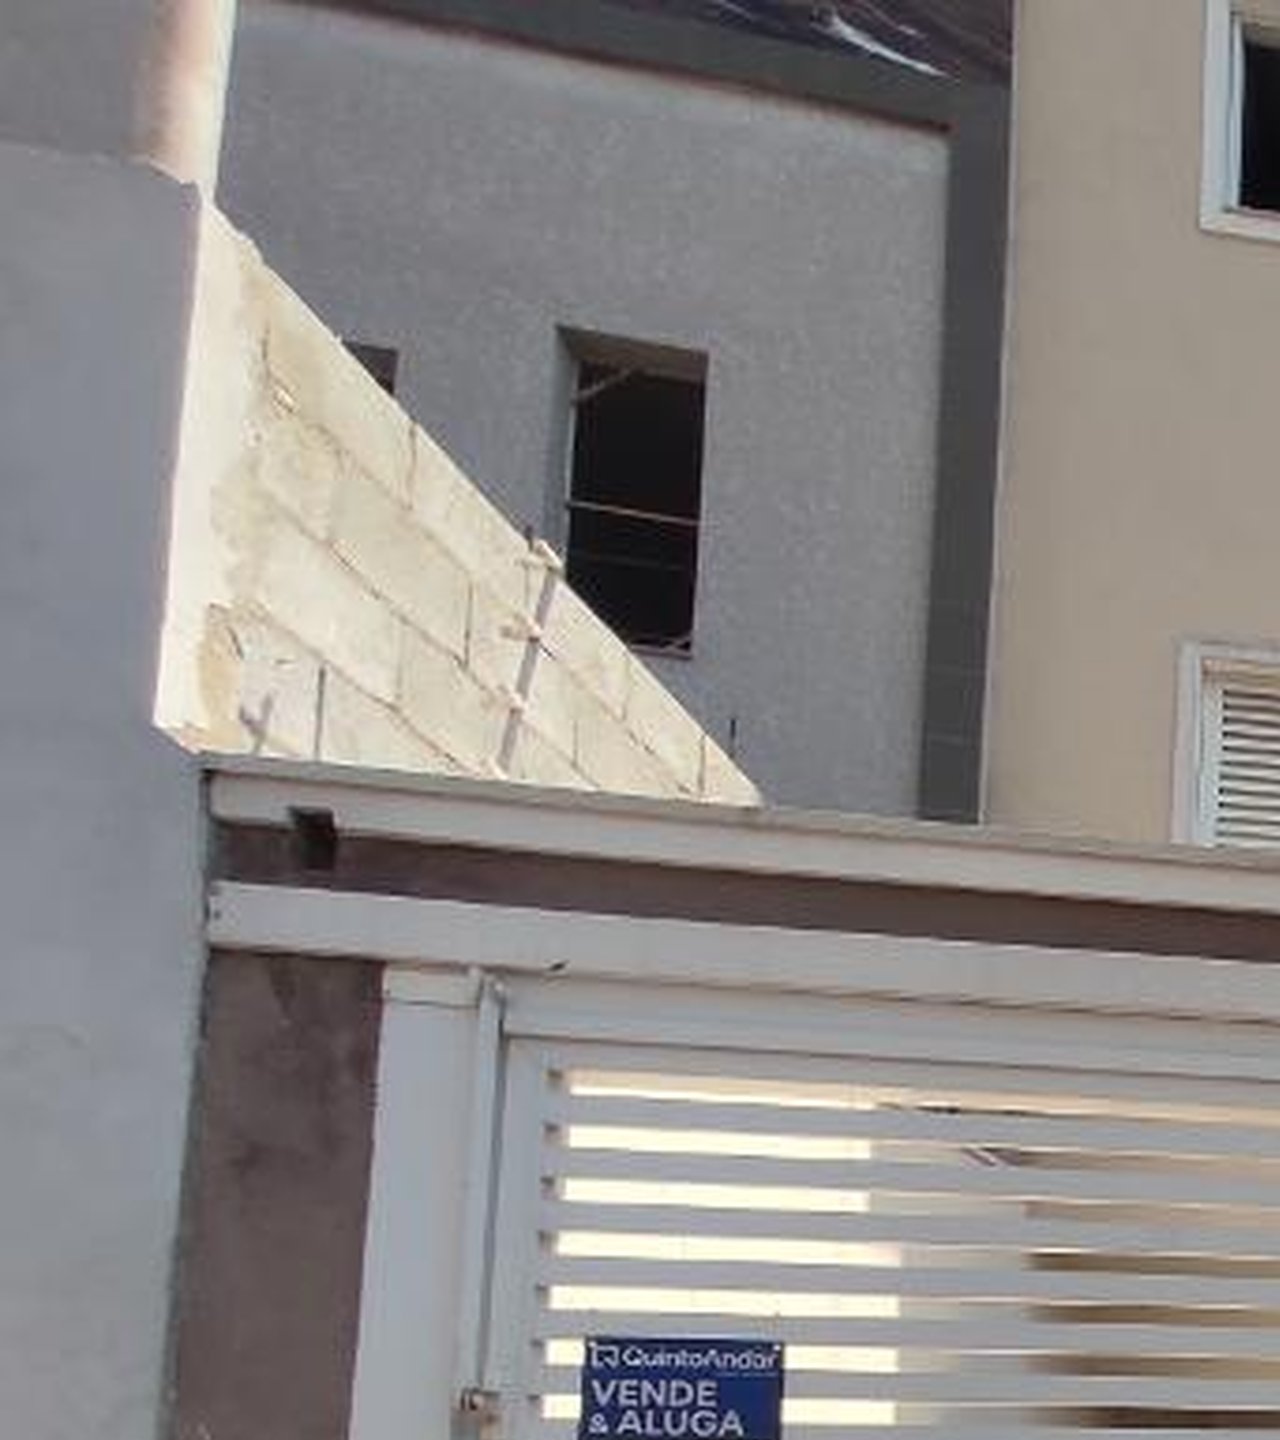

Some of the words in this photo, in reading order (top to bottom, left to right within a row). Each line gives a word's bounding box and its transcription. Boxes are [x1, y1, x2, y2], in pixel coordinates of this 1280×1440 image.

[622, 1346, 776, 1370] QuintoAndar
[591, 1380, 717, 1407] VENDE
[588, 1413, 609, 1434] &
[617, 1410, 744, 1437] ALUGA
